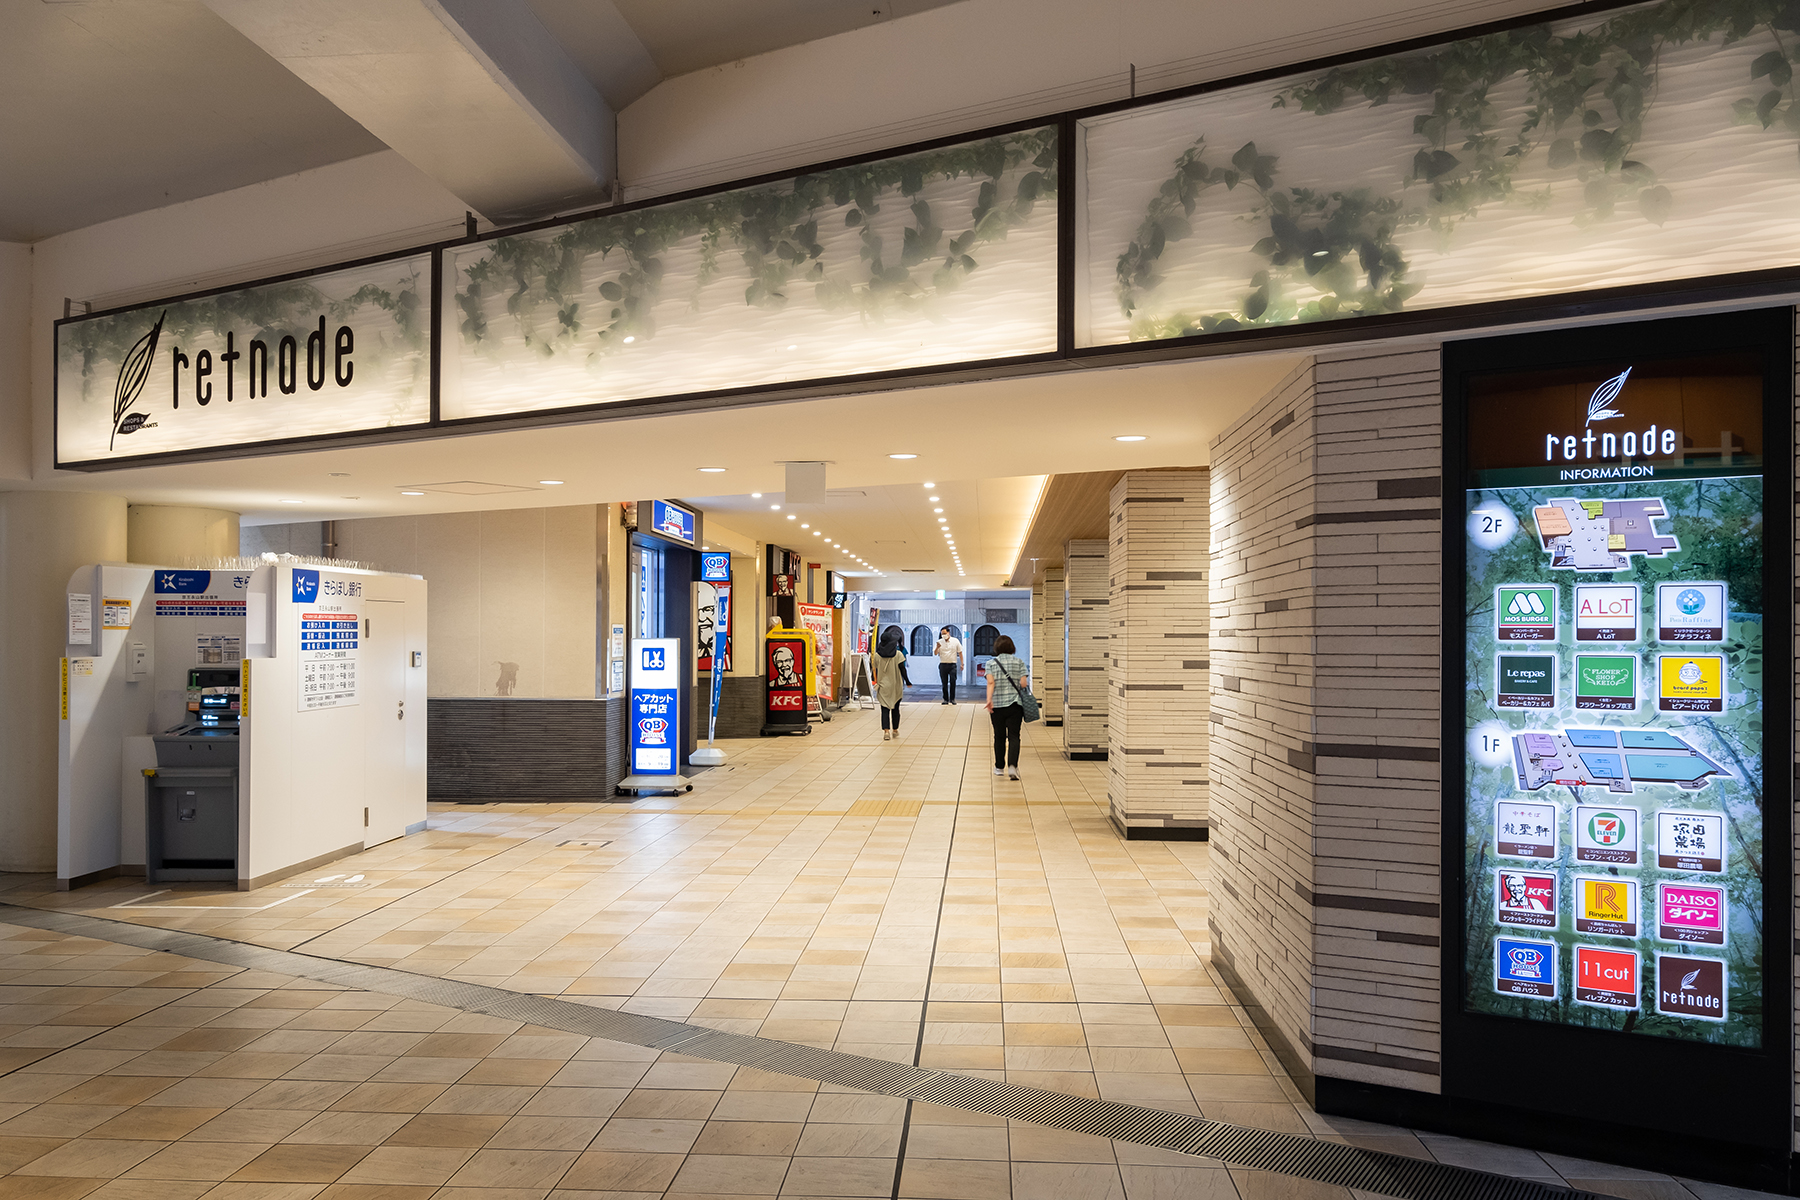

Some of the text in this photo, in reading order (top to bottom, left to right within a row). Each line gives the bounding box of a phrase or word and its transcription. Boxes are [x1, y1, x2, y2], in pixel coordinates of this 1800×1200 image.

[123, 417, 140, 425] SHOPS
[1560, 465, 1654, 481] INFORMATION
[1482, 516, 1503, 533] 2F
[708, 557, 724, 569] QB
[324, 580, 362, 597] きらぼし銀行
[1580, 599, 1593, 614] A
[1506, 669, 1546, 679] Le repas
[633, 693, 674, 703] ヘアカット
[771, 695, 801, 706] KFC
[639, 704, 668, 714] 専門店
[643, 719, 662, 731] QB
[1482, 734, 1500, 753] 1F
[1597, 819, 1617, 843] 7
[1527, 887, 1553, 897] KFC
[1666, 893, 1717, 907] DAISO
[1588, 910, 1624, 920] Ringer Hut
[1668, 907, 1715, 920] ダイソー
[1587, 925, 1626, 935] リンガーハット
[1678, 933, 1705, 941] ダイソー
[1514, 950, 1535, 962] QB
[1522, 987, 1540, 995] ハウス
[1584, 994, 1609, 1002] イレブン
[1610, 997, 1629, 1005] カット
